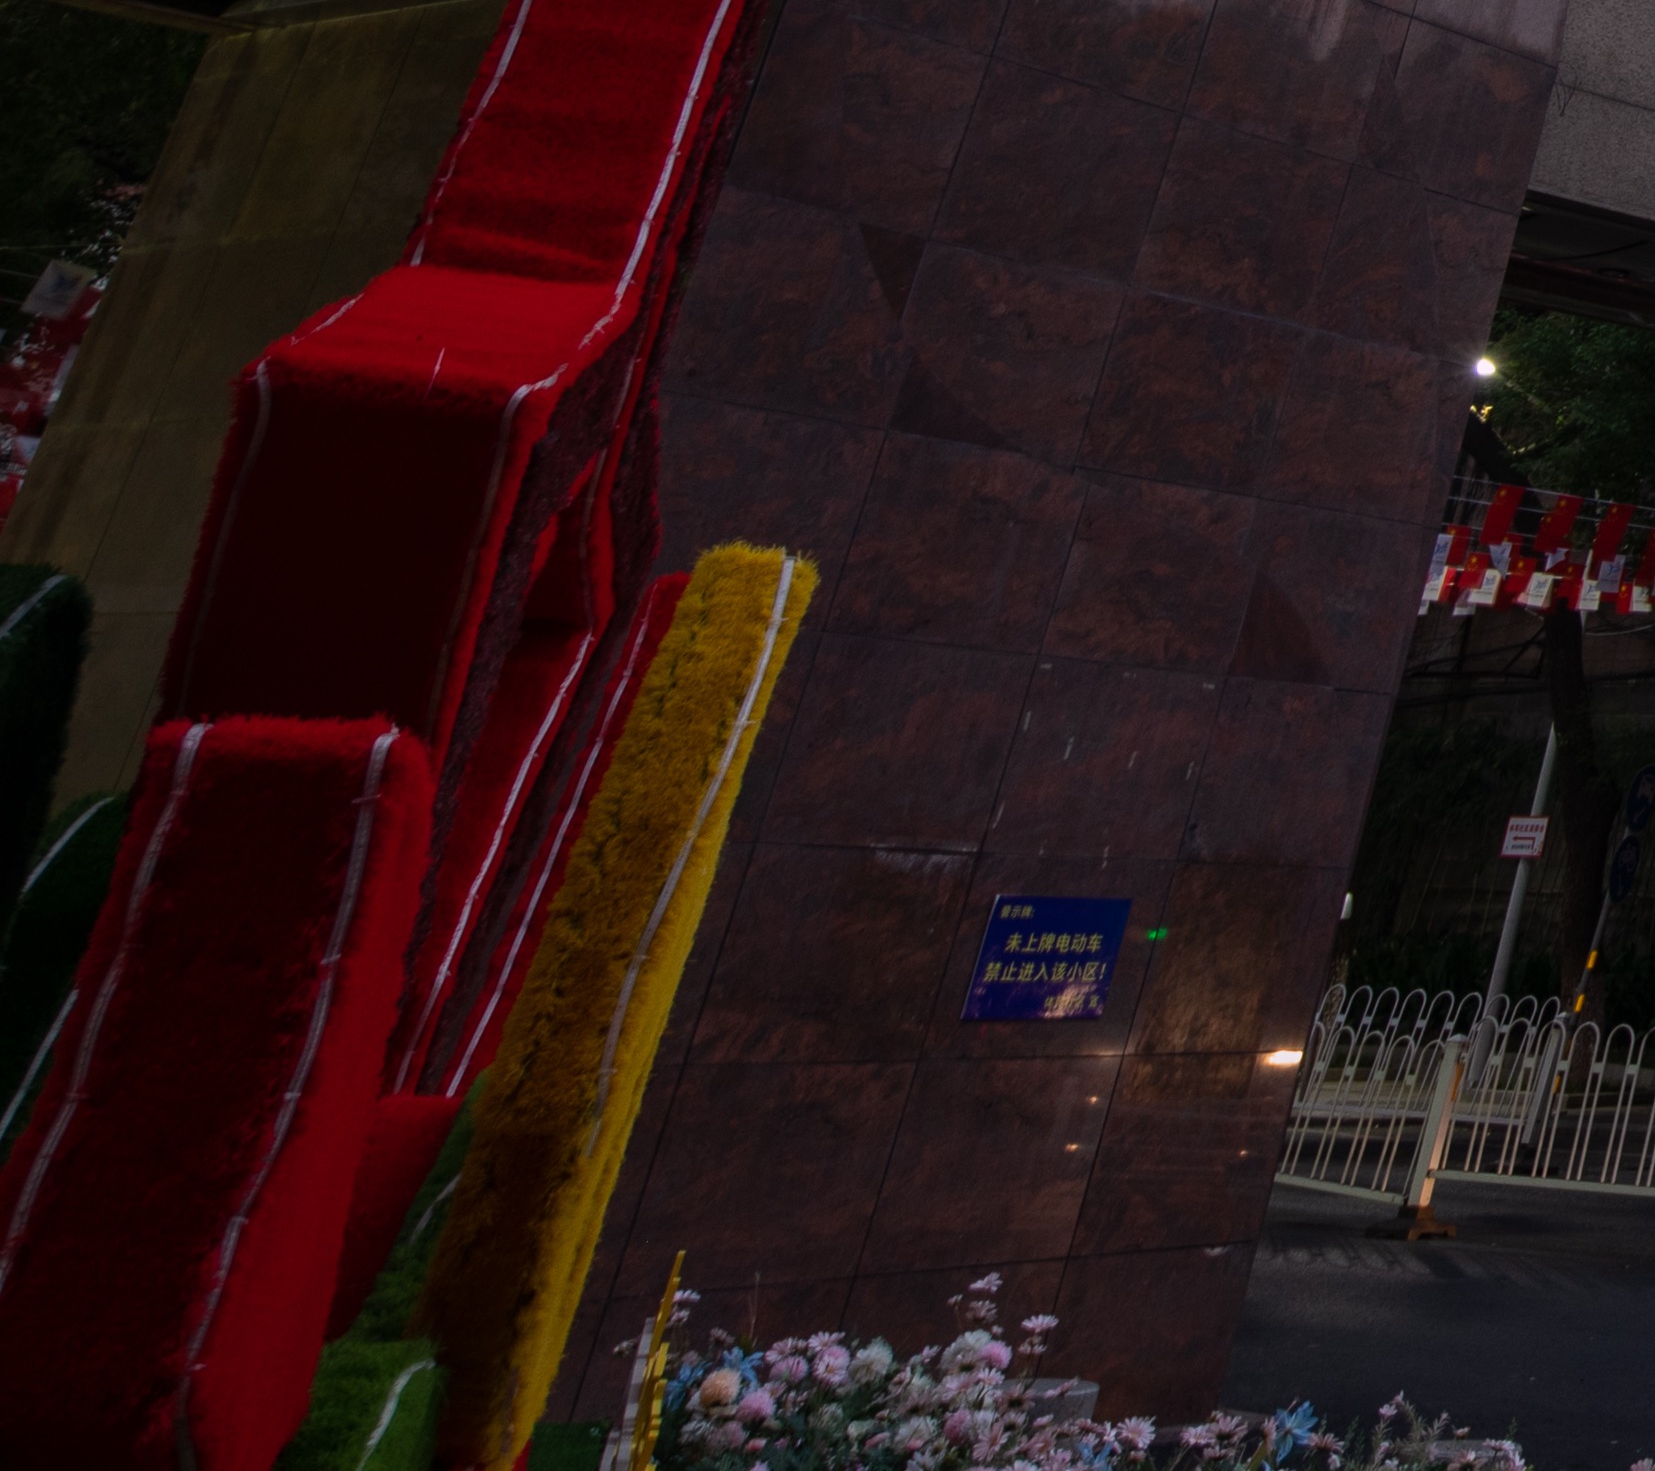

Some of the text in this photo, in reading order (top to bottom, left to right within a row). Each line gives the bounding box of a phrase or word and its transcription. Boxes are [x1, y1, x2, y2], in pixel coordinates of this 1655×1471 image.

[1004, 931, 1103, 953] 未上牌电动车
